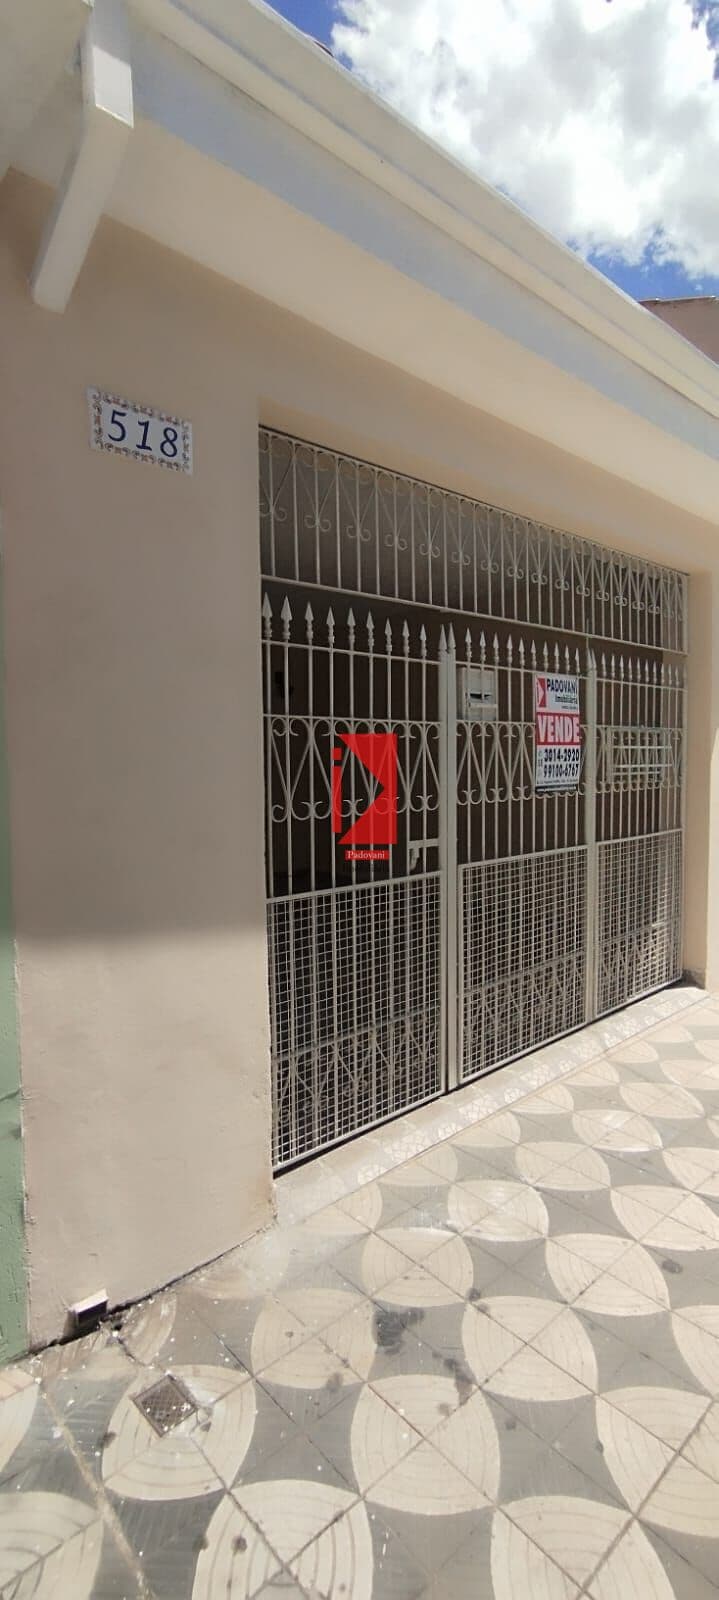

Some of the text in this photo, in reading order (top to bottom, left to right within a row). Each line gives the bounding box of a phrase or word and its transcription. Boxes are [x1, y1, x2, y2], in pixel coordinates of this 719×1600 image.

[108, 409, 178, 457] 518
[546, 678, 577, 694] PADOVANI
[537, 714, 580, 743] VENDE
[544, 748, 579, 762] 3014-2920
